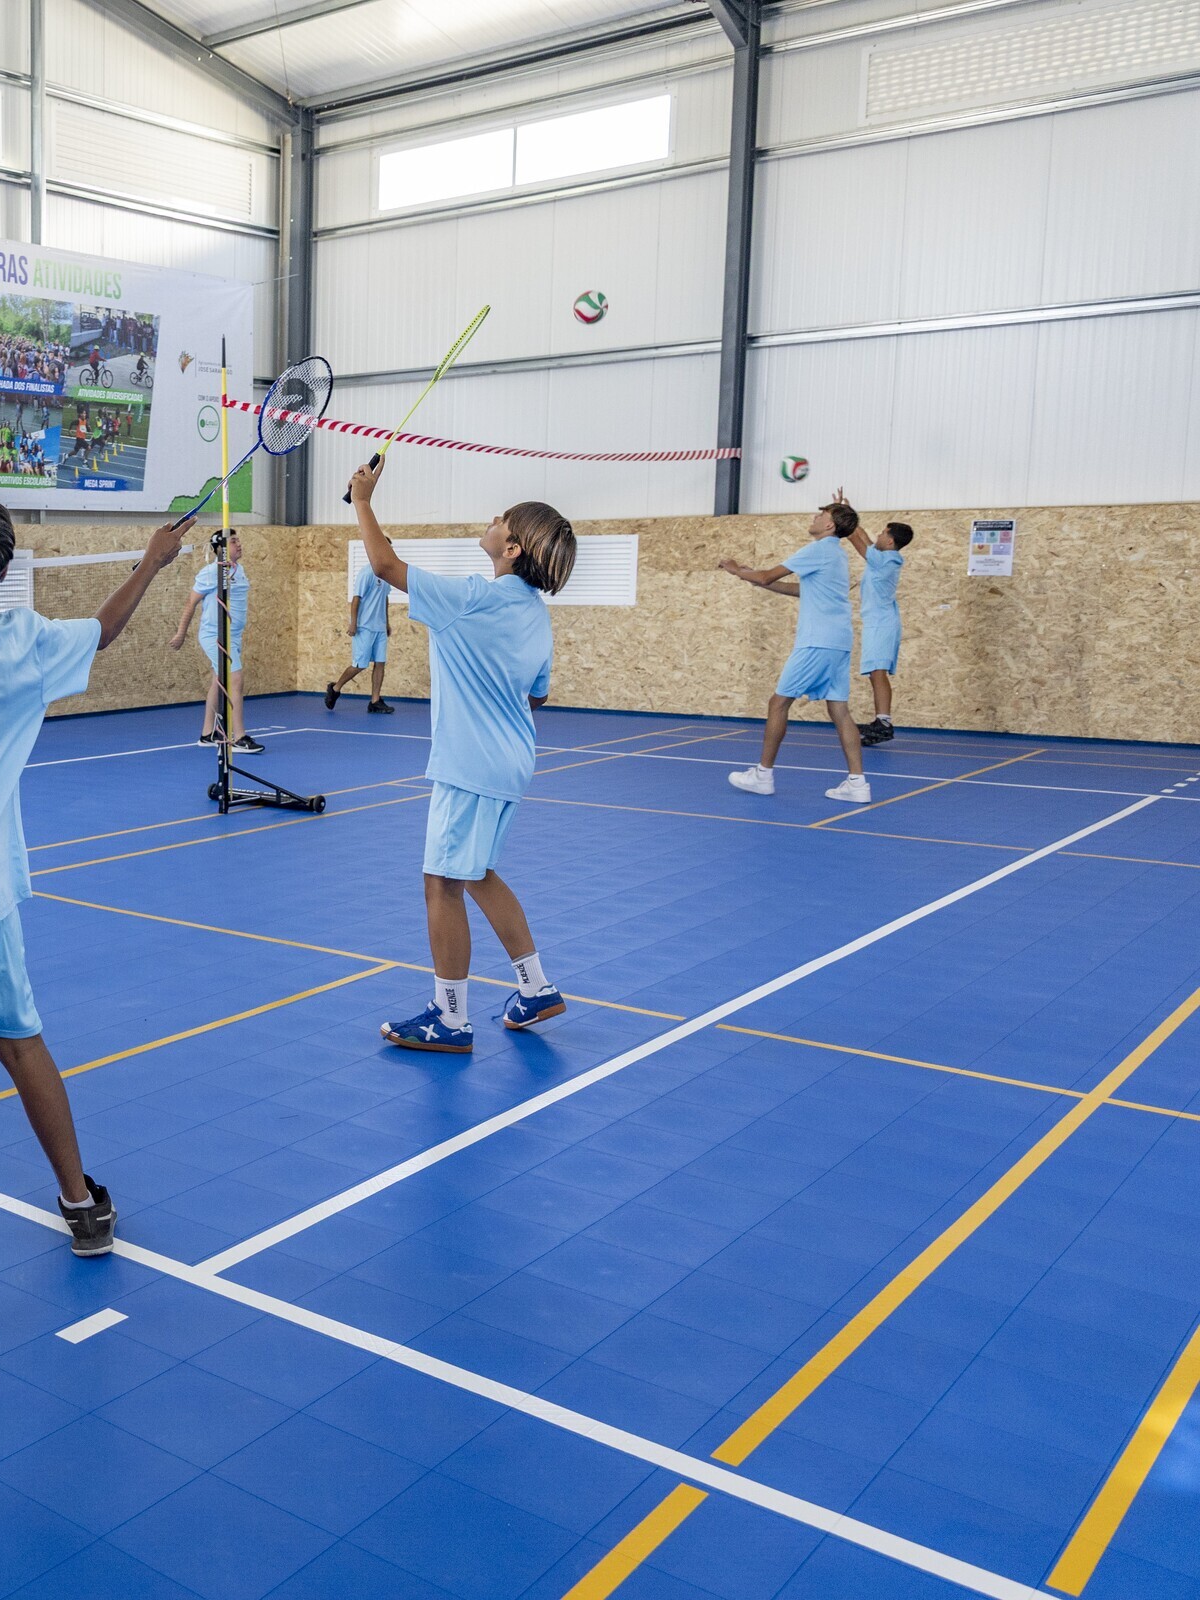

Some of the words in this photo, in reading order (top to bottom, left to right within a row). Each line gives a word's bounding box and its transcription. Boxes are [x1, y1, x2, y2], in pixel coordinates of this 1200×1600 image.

[33, 258, 122, 300] ATIVIDADES
[14, 381, 26, 391] DOS
[26, 382, 55, 394] FINALISTAS
[78, 388, 106, 399] ATIVIDADES
[23, 476, 52, 486] ESCOLARES
[84, 479, 98, 488] MEGA
[98, 479, 117, 489] SPRINT
